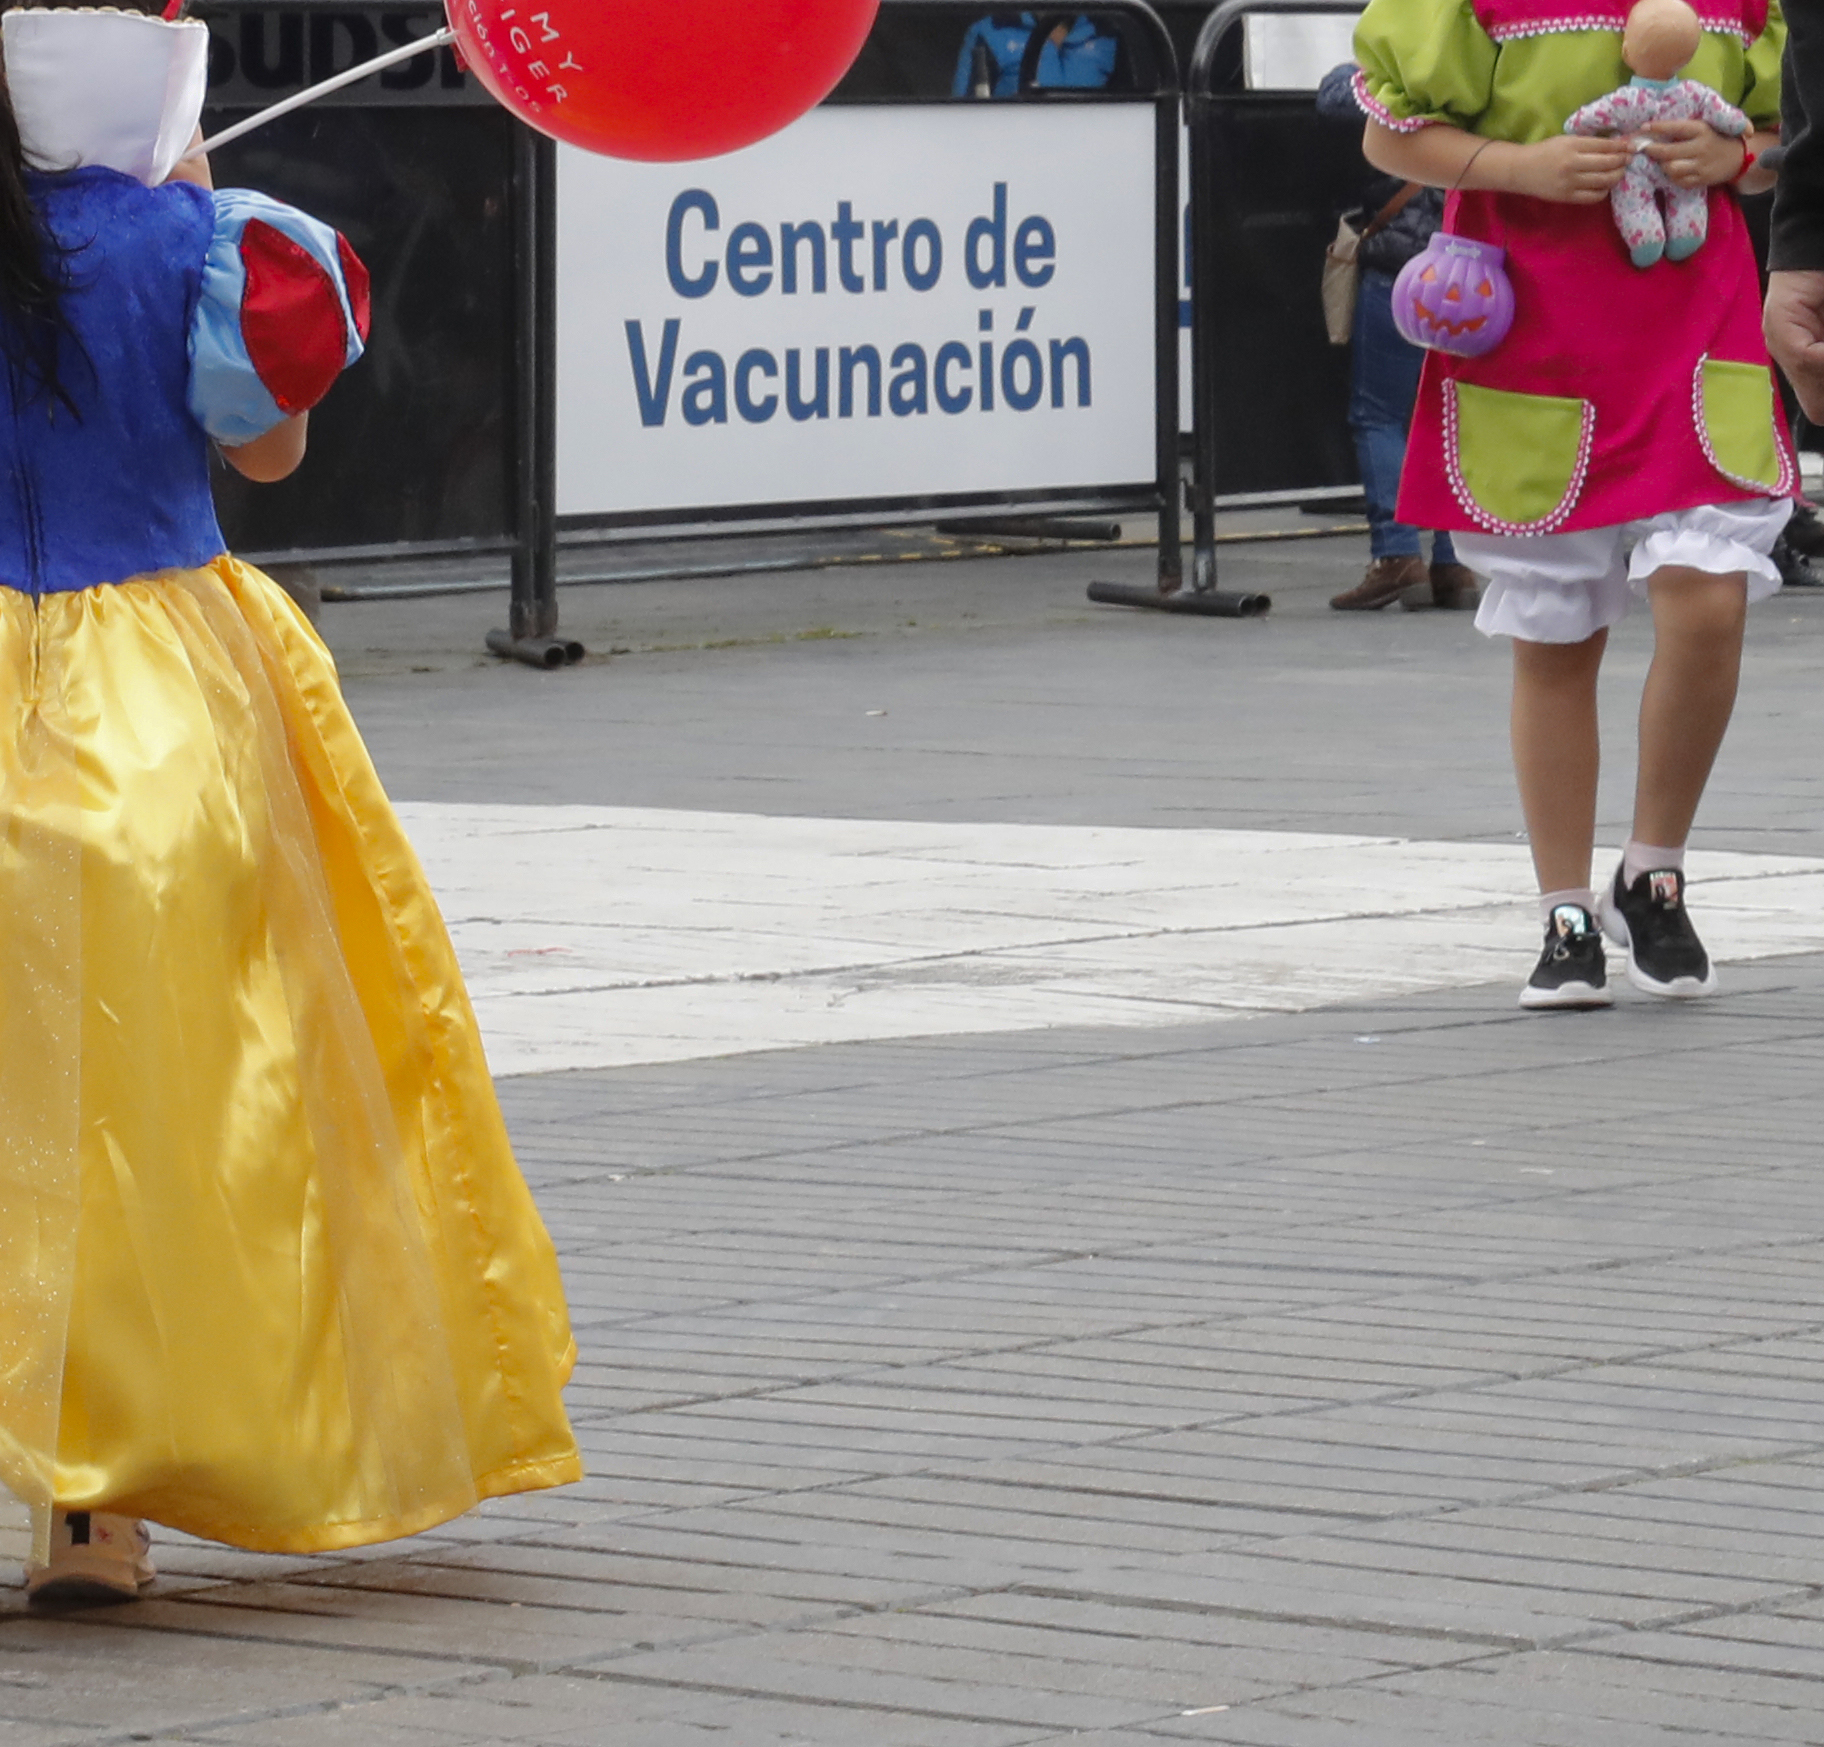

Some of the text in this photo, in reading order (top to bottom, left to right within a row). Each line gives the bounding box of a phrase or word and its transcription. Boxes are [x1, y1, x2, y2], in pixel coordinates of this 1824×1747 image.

[665, 181, 1057, 299] Centro de
[623, 306, 1092, 428] Vacunación
